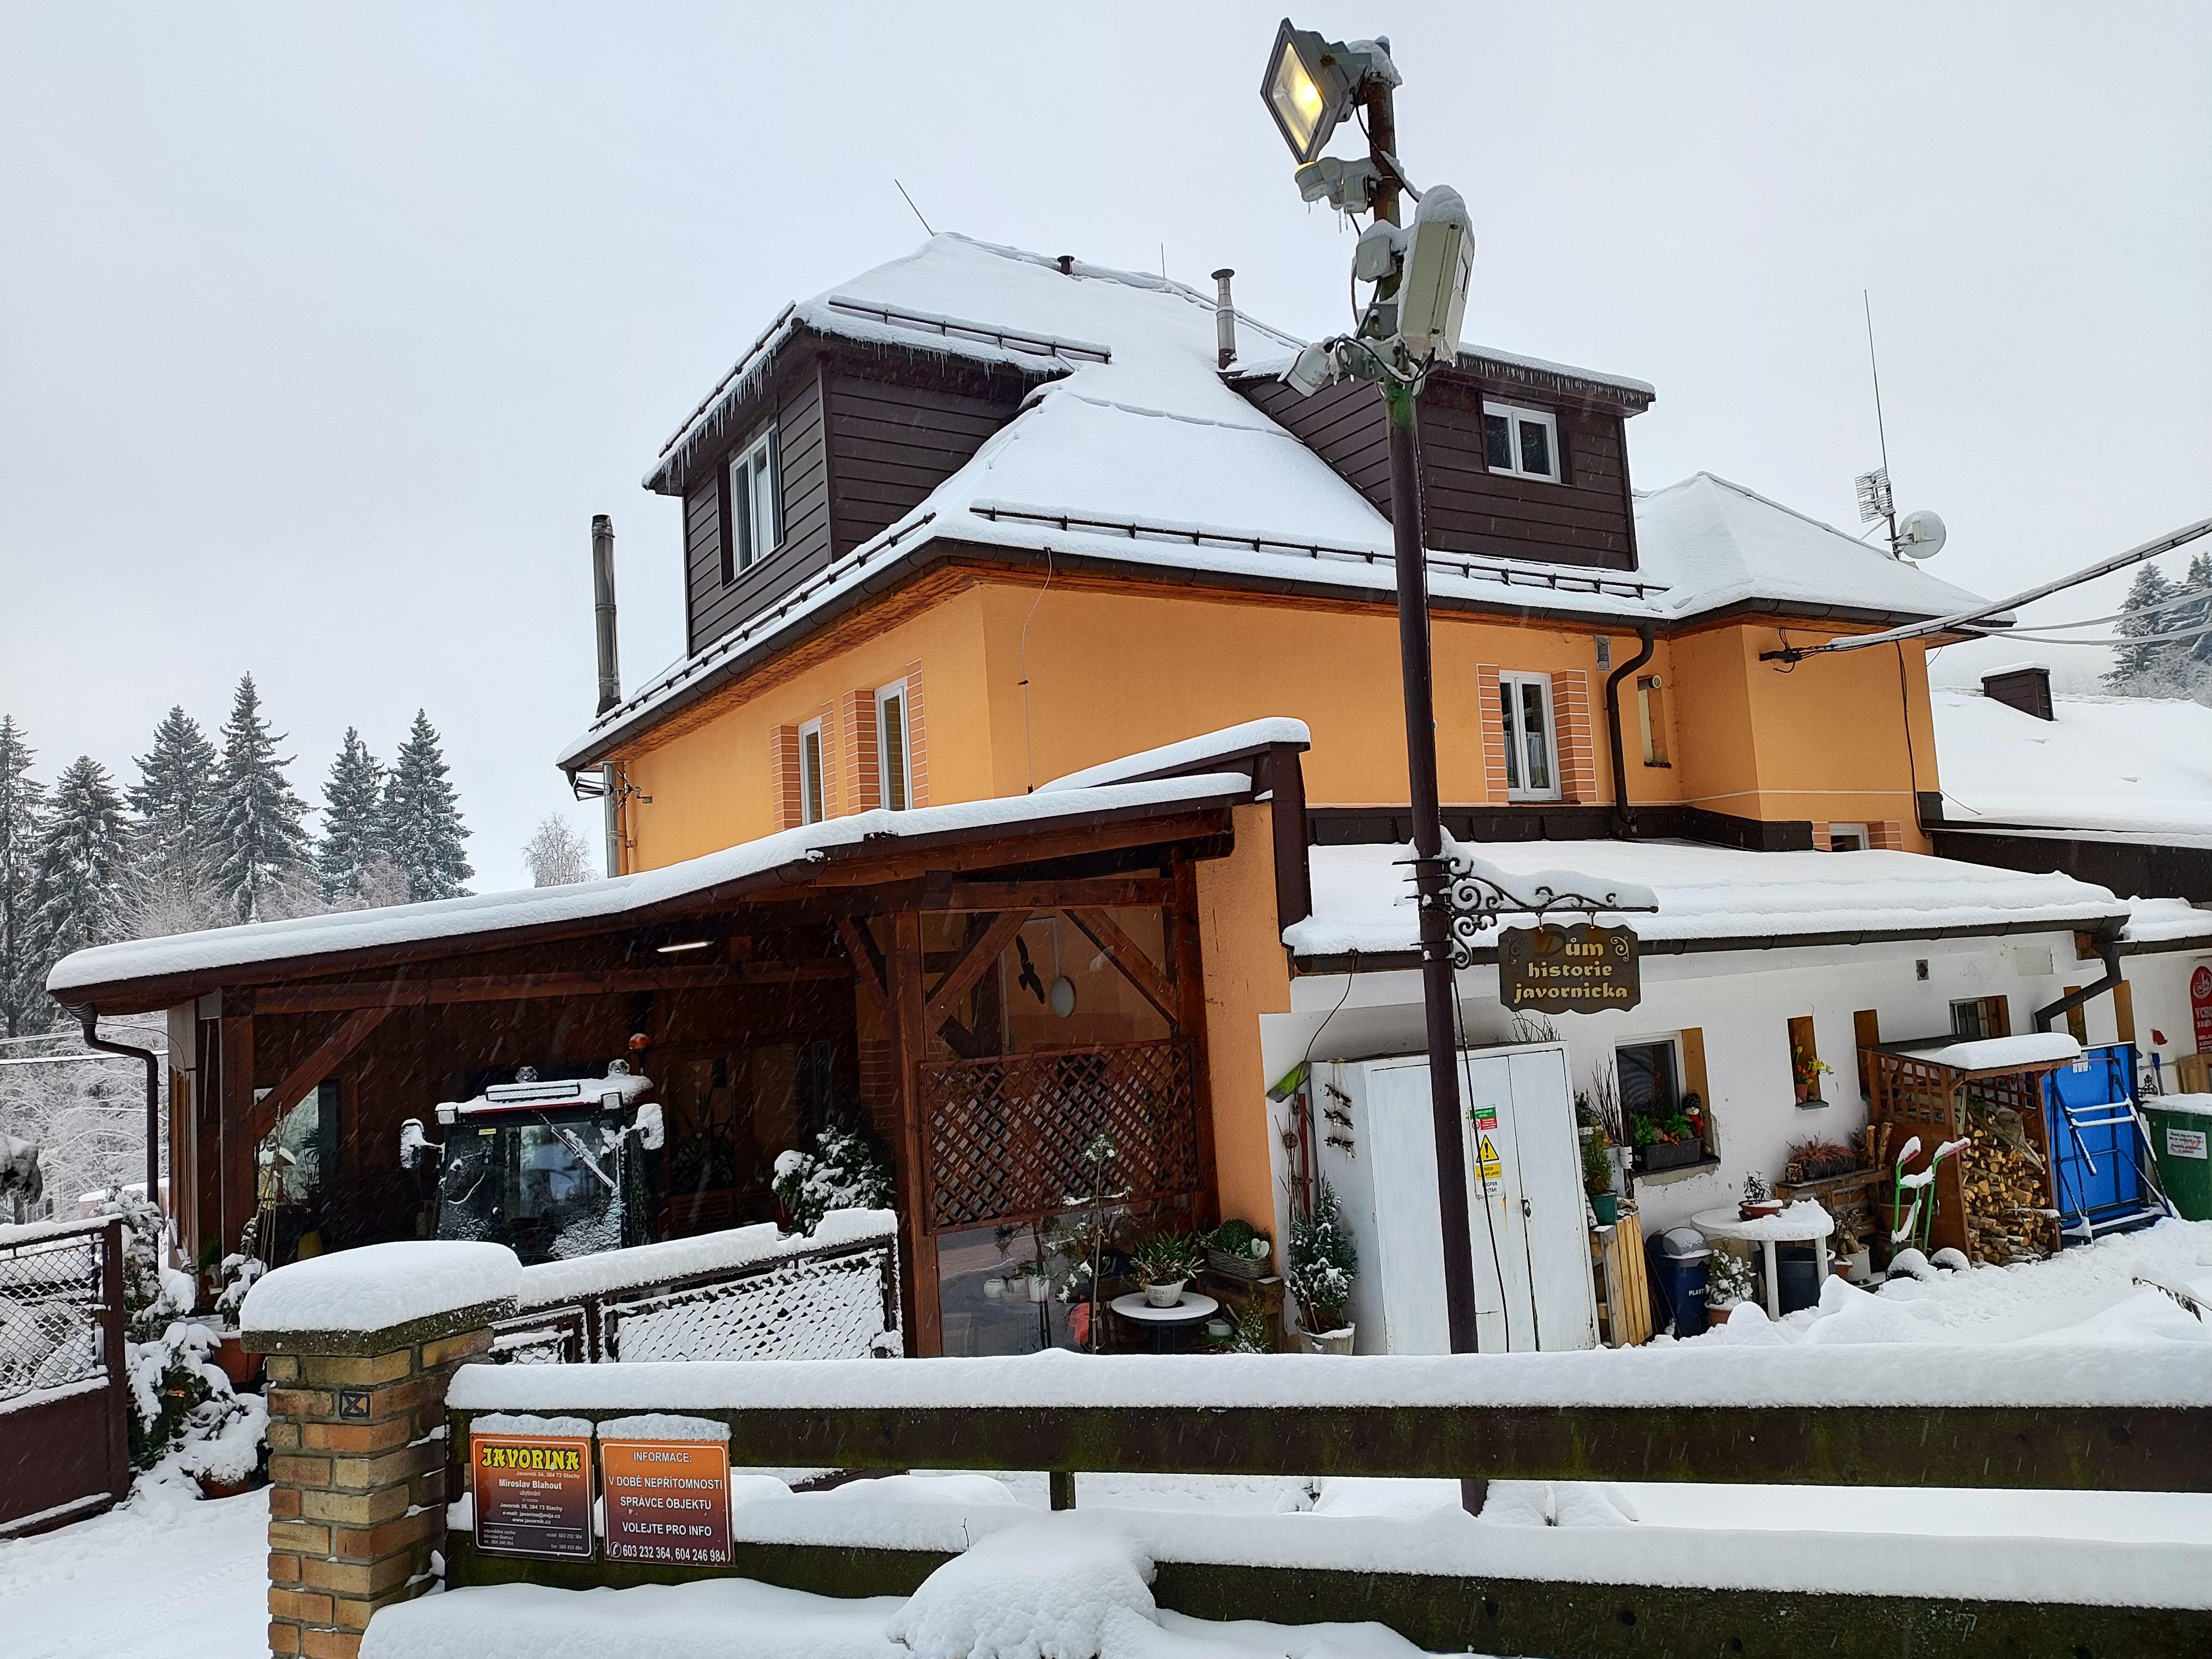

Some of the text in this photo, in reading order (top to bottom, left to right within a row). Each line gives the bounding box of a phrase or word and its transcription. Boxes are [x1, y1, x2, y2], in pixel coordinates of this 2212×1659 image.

[1534, 931, 1604, 958] Dům
[1528, 961, 1613, 979] historie
[1514, 982, 1627, 1004] javornicka
[481, 1447, 580, 1471] JAVORINA
[633, 1451, 692, 1463] INFORMACE:
[499, 1479, 562, 1490] Miroslav Blahout
[608, 1475, 723, 1490] V DOBĚ NEPŘÍTOMNOSTI
[620, 1495, 712, 1510] SPRÁVCE OBJEKTU
[622, 1522, 712, 1537] VOLEJTE PRO INFO
[623, 1545, 726, 1562] 603 232 364, 604 246 984
